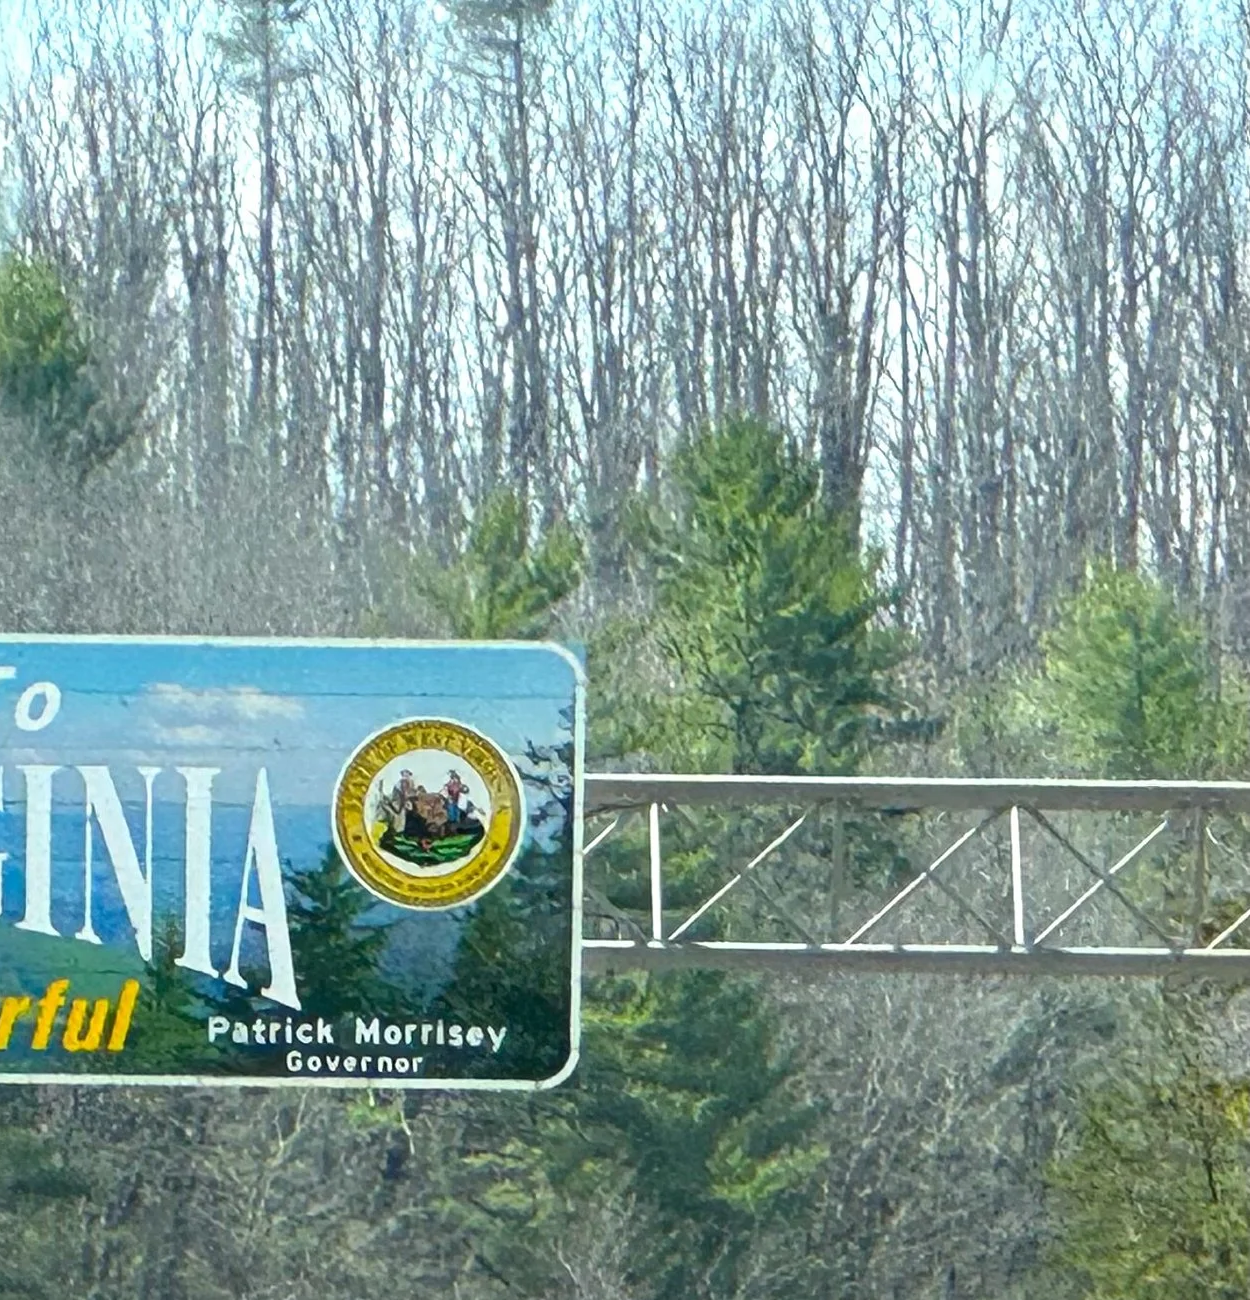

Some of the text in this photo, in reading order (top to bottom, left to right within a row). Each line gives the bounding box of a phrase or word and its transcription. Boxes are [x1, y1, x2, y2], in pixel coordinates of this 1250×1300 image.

[208, 1016, 507, 1052] Patrick Morrisey
[286, 1050, 423, 1073] Governor
